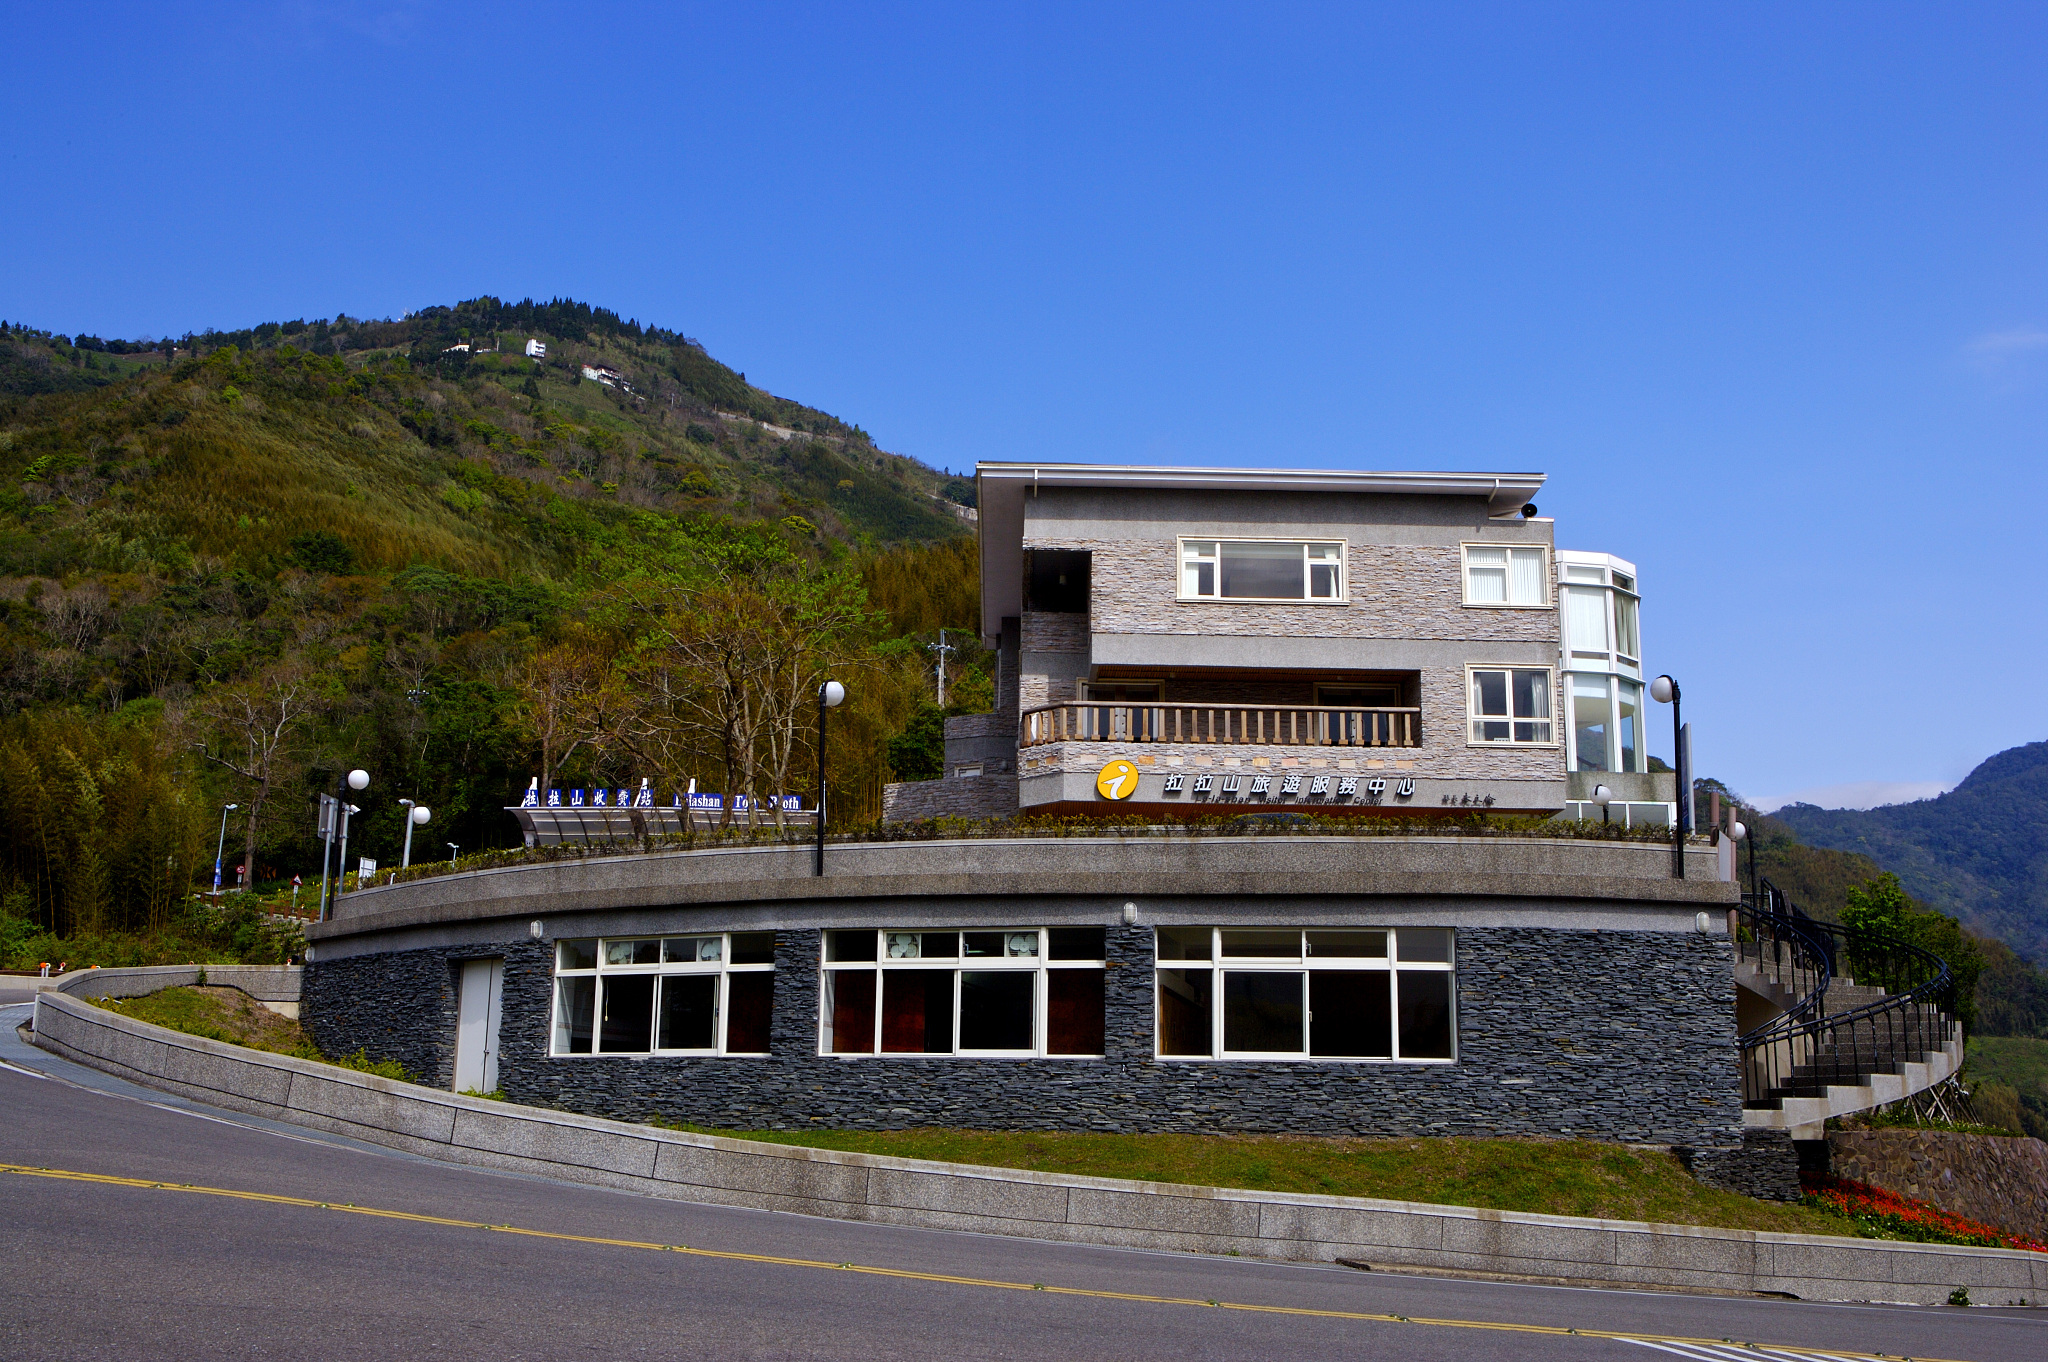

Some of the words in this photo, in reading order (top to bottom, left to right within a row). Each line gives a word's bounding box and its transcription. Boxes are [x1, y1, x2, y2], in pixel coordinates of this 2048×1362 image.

[1165, 774, 1415, 795] 拉拉山旅遊服務中心
[525, 789, 650, 806] 拉拉山收費站
[674, 794, 721, 808] Llashan
[735, 795, 758, 808] To
[770, 796, 799, 810] Both
[1258, 795, 1287, 804] Visitor
[1295, 796, 1347, 805] Information
[1353, 796, 1384, 806] Center
